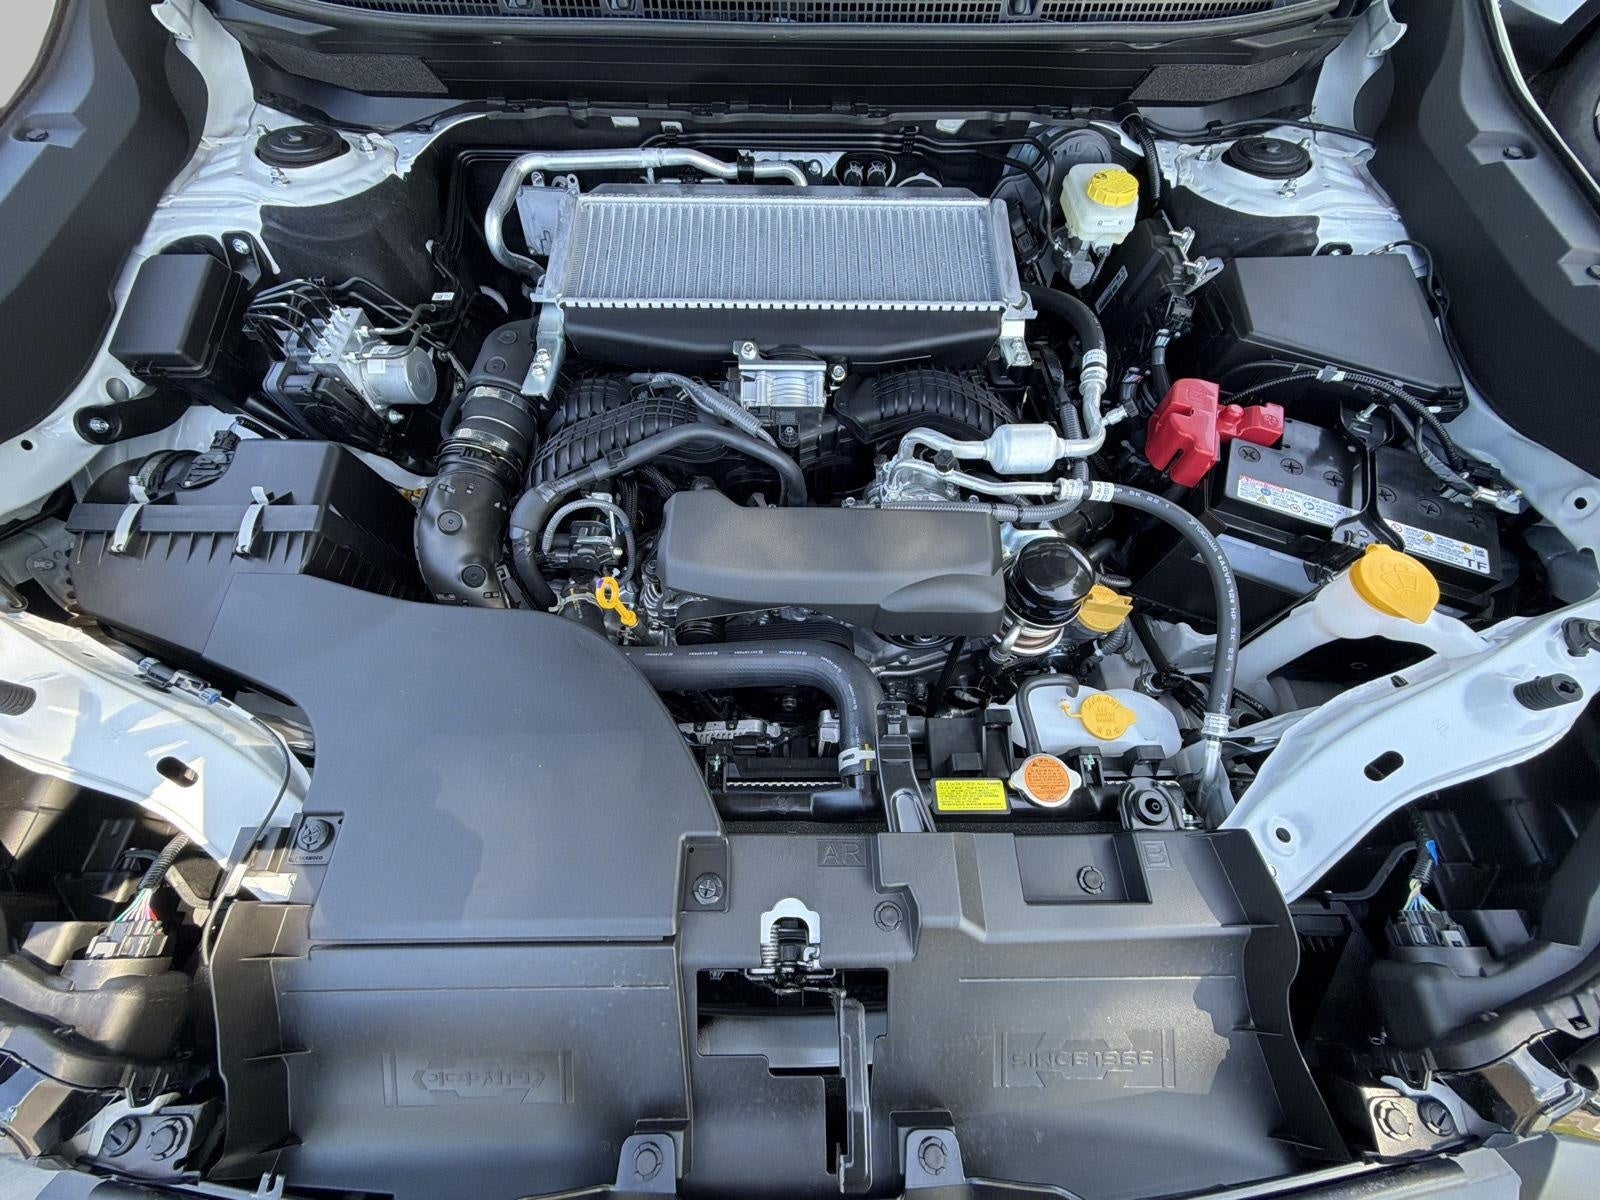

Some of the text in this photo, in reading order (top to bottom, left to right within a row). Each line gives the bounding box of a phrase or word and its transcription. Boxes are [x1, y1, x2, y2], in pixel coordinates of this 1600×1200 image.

[1196, 526, 1218, 552] YOKOHAMA
[1229, 607, 1237, 620] HP
[1464, 557, 1487, 570] TF
[822, 843, 861, 865] AR
[1146, 846, 1166, 866] B
